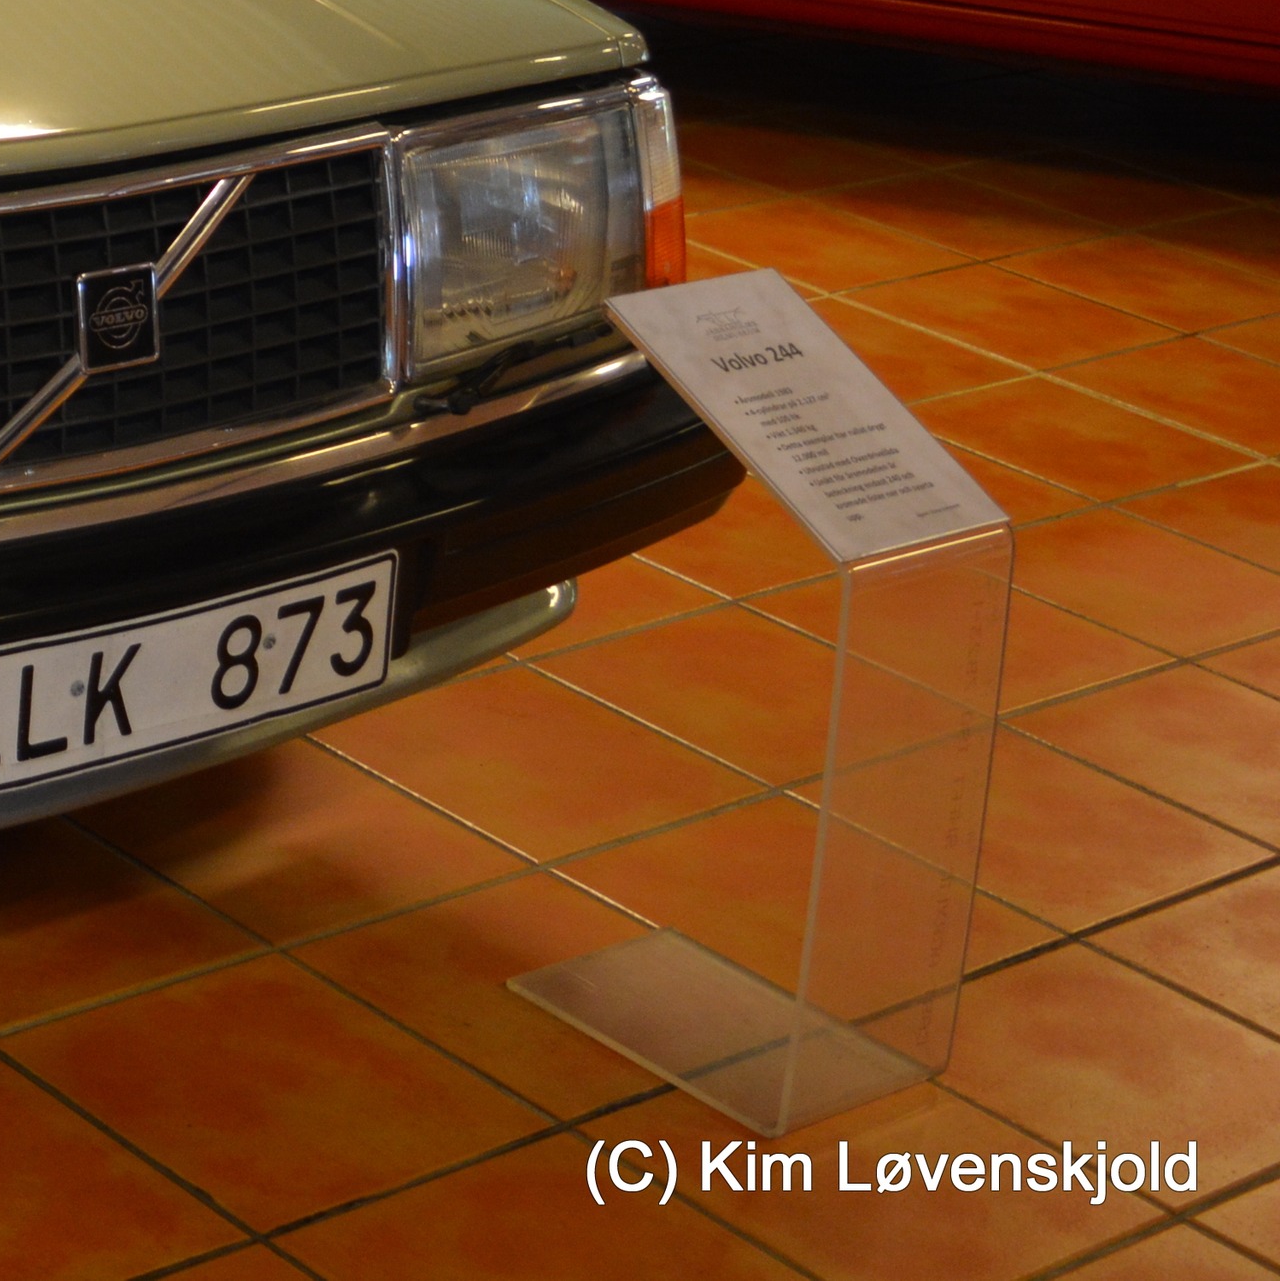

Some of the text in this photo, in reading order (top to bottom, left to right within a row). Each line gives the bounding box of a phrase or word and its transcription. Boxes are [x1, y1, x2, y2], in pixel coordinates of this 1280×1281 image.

[92, 308, 145, 327] VOLVO
[711, 342, 804, 372] Volvo 244
[211, 580, 377, 710] 873
